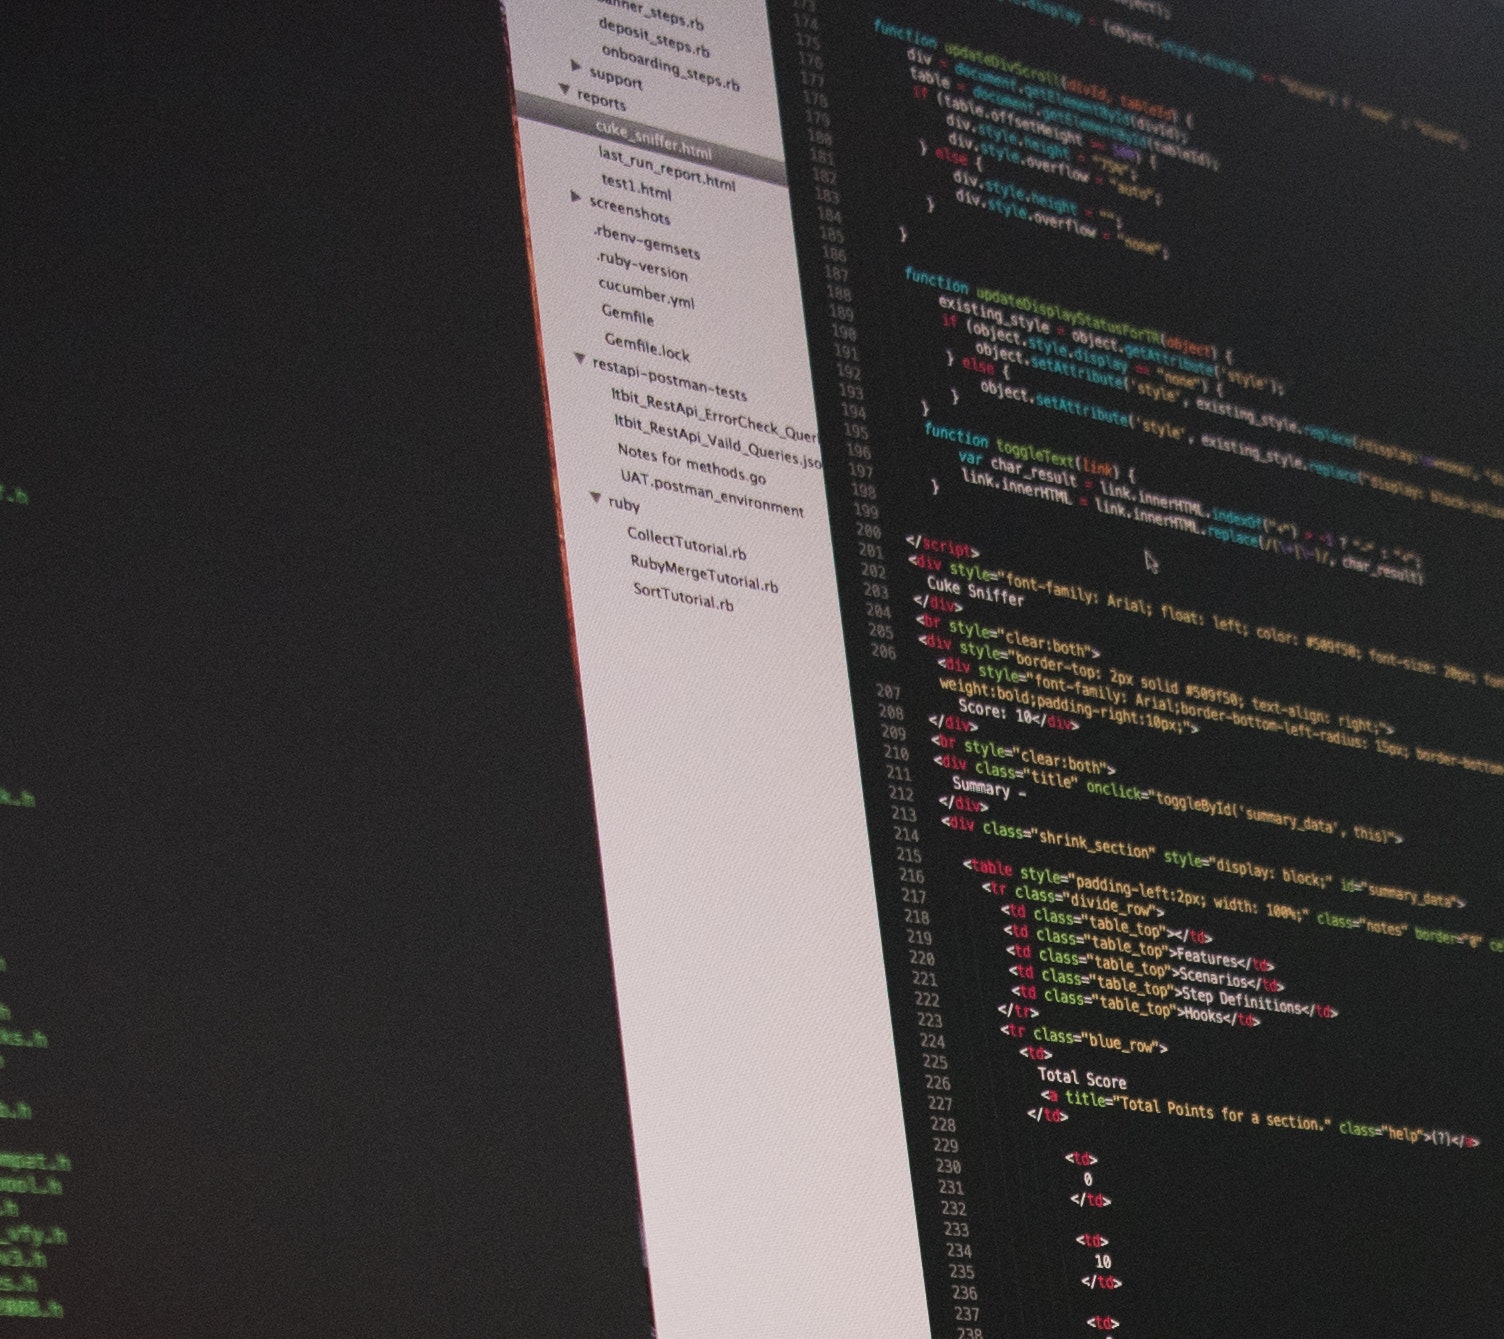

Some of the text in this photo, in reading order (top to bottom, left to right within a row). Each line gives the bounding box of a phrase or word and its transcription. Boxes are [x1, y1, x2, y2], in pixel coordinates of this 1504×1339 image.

[599, 17, 710, 59] deposit_steps.rb
[589, 67, 643, 91] support
[602, 44, 740, 92] onboarding_steps.rb
[577, 90, 627, 112] reports
[596, 121, 712, 162] cuke_sniffer.html
[599, 145, 736, 193] last_run_report.html
[602, 174, 672, 201] test1.html
[590, 196, 671, 226] screenshots
[594, 225, 701, 260] .rbenv-gemsets
[597, 251, 688, 282] .ruby-version
[902, 263, 968, 294] function
[599, 278, 695, 310] cucumber.yml
[602, 303, 654, 327] Gemfile
[605, 332, 690, 363] Gemfile.lock
[593, 358, 747, 402] restapi-postman-tests
[618, 443, 766, 486] Notes for methods.go
[608, 497, 640, 514] ruby
[620, 469, 804, 518] UAT.postman_environment
[627, 527, 747, 561] CollectTutorial.rb
[905, 532, 980, 562] </script>
[631, 554, 779, 594] RubyMergeTutorial.rb
[926, 573, 1024, 608] Cuke Sniffer
[633, 582, 734, 612] SortTutorial.rb
[913, 592, 963, 615] </div>
[958, 696, 1079, 733] Score: 10</div>
[933, 752, 1078, 789] <div class="title"
[952, 774, 1011, 803] Summary
[1003, 921, 1274, 974] <td class="table_top">Features</td>
[1037, 1064, 1127, 1090] Total Score
[1064, 1087, 1331, 1131] title="Total Points for a section."
